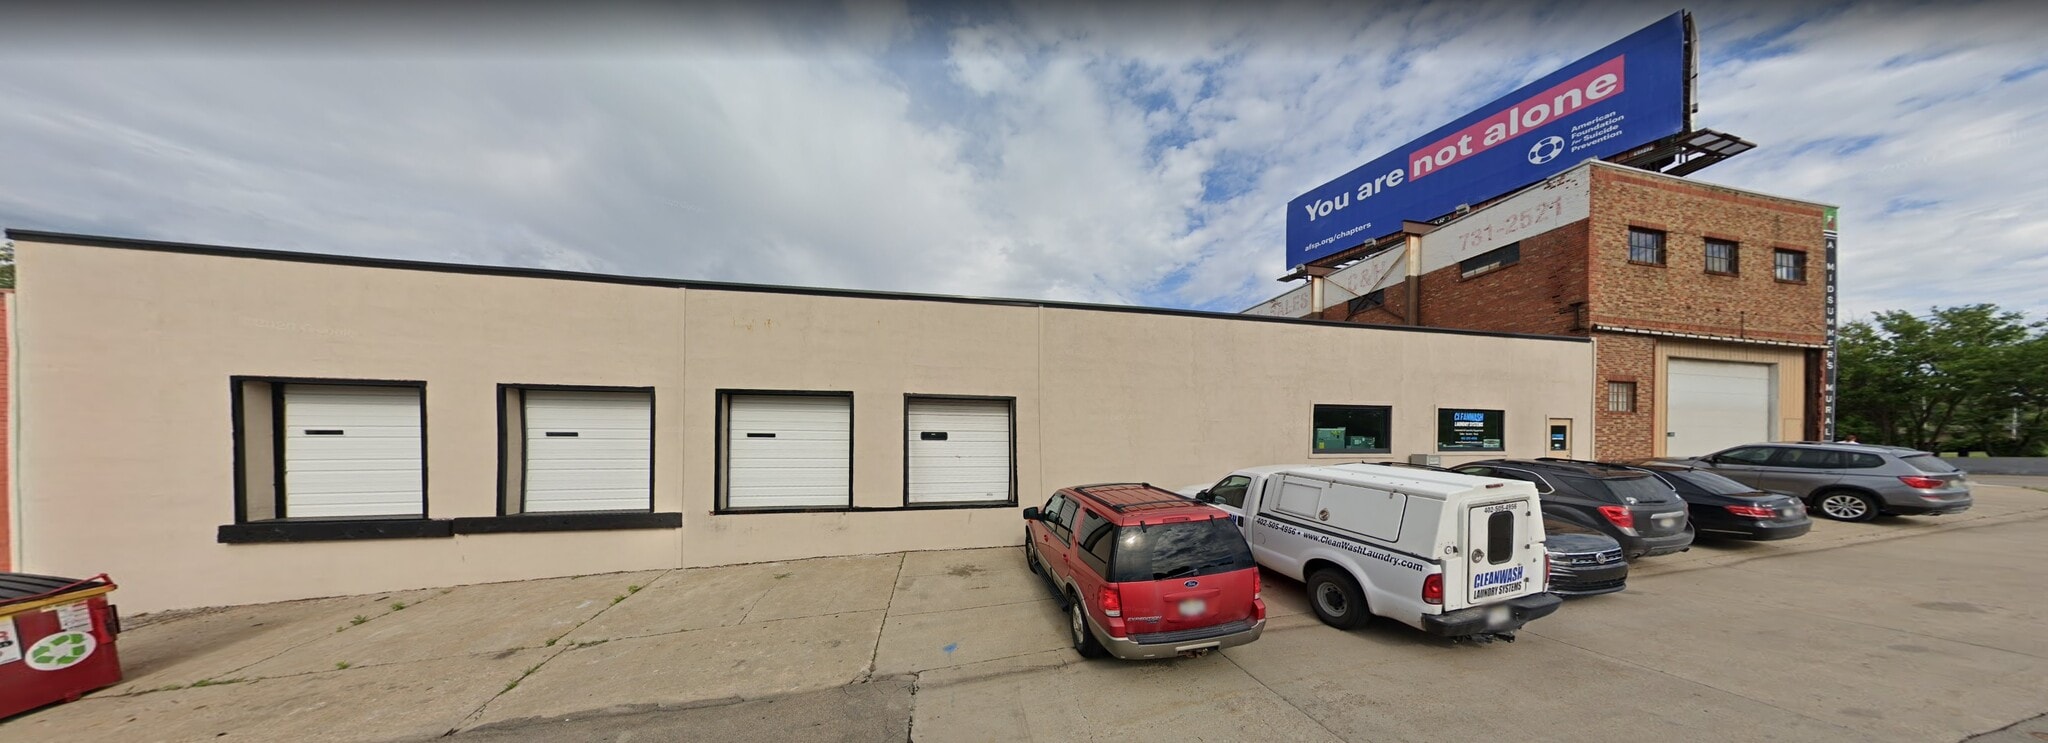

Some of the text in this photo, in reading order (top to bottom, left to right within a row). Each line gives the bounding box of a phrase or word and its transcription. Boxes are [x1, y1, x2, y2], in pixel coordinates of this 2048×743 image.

[1571, 111, 1616, 133] American
[1571, 115, 1625, 139] Foundation
[1583, 124, 1619, 142] Suicide
[1305, 72, 1618, 222] You are not alone
[1571, 130, 1623, 153] Prevention
[1304, 222, 1372, 252] afsp.org/chapters
[1824, 241, 1835, 436] A MIDSUMMER'S MURAL
[1256, 517, 1424, 572] 402-505-4956 www.CleanWashLaundry.com
[1473, 565, 1524, 589] CLEANWASH
[1473, 581, 1522, 600] LAUNDRY SYSTEMS
